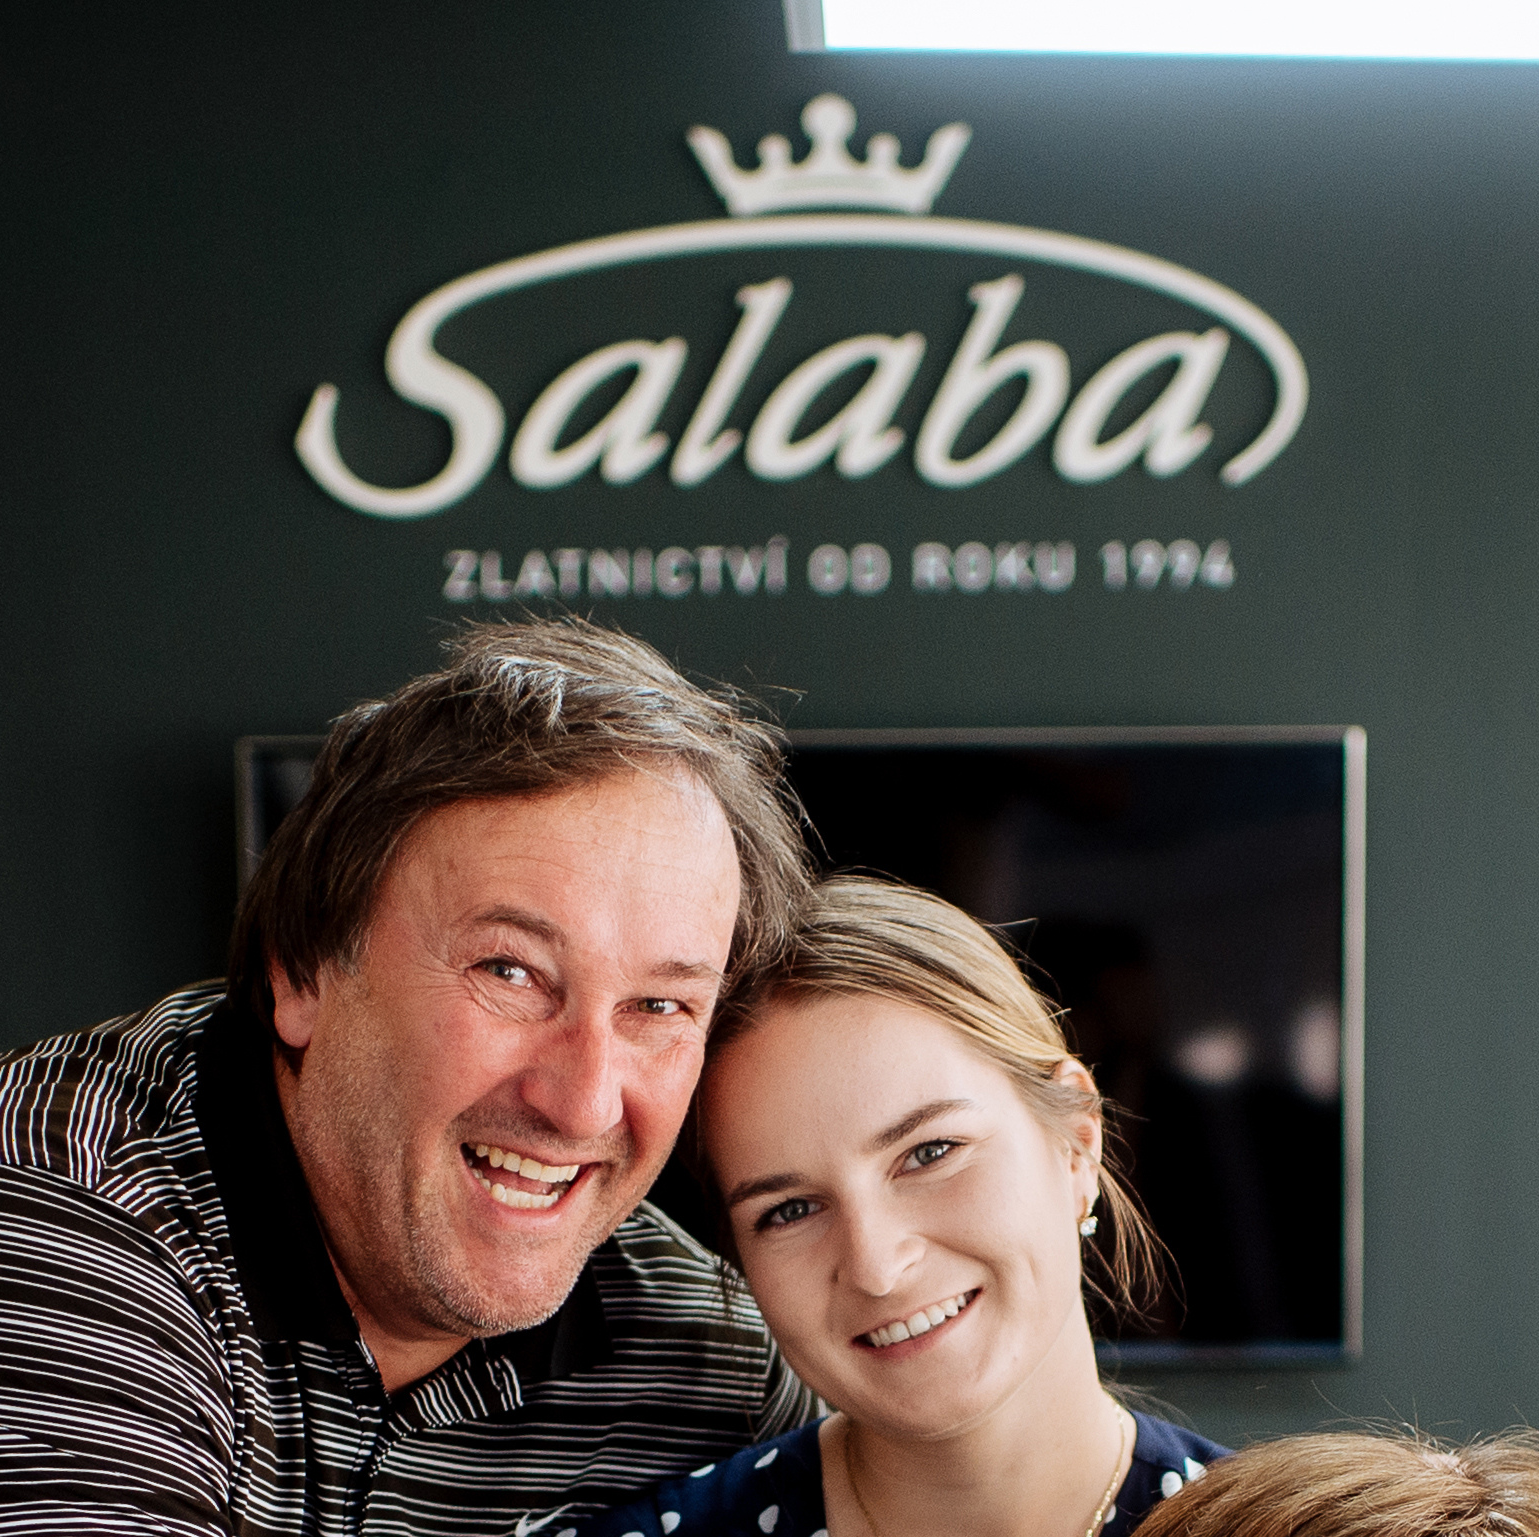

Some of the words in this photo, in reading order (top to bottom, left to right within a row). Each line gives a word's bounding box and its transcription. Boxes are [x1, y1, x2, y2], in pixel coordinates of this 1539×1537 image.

[296, 213, 1310, 519] Salaba
[442, 535, 787, 599] ZLATNICTVÍ
[806, 543, 892, 594] OD
[912, 541, 1075, 591] ROKU
